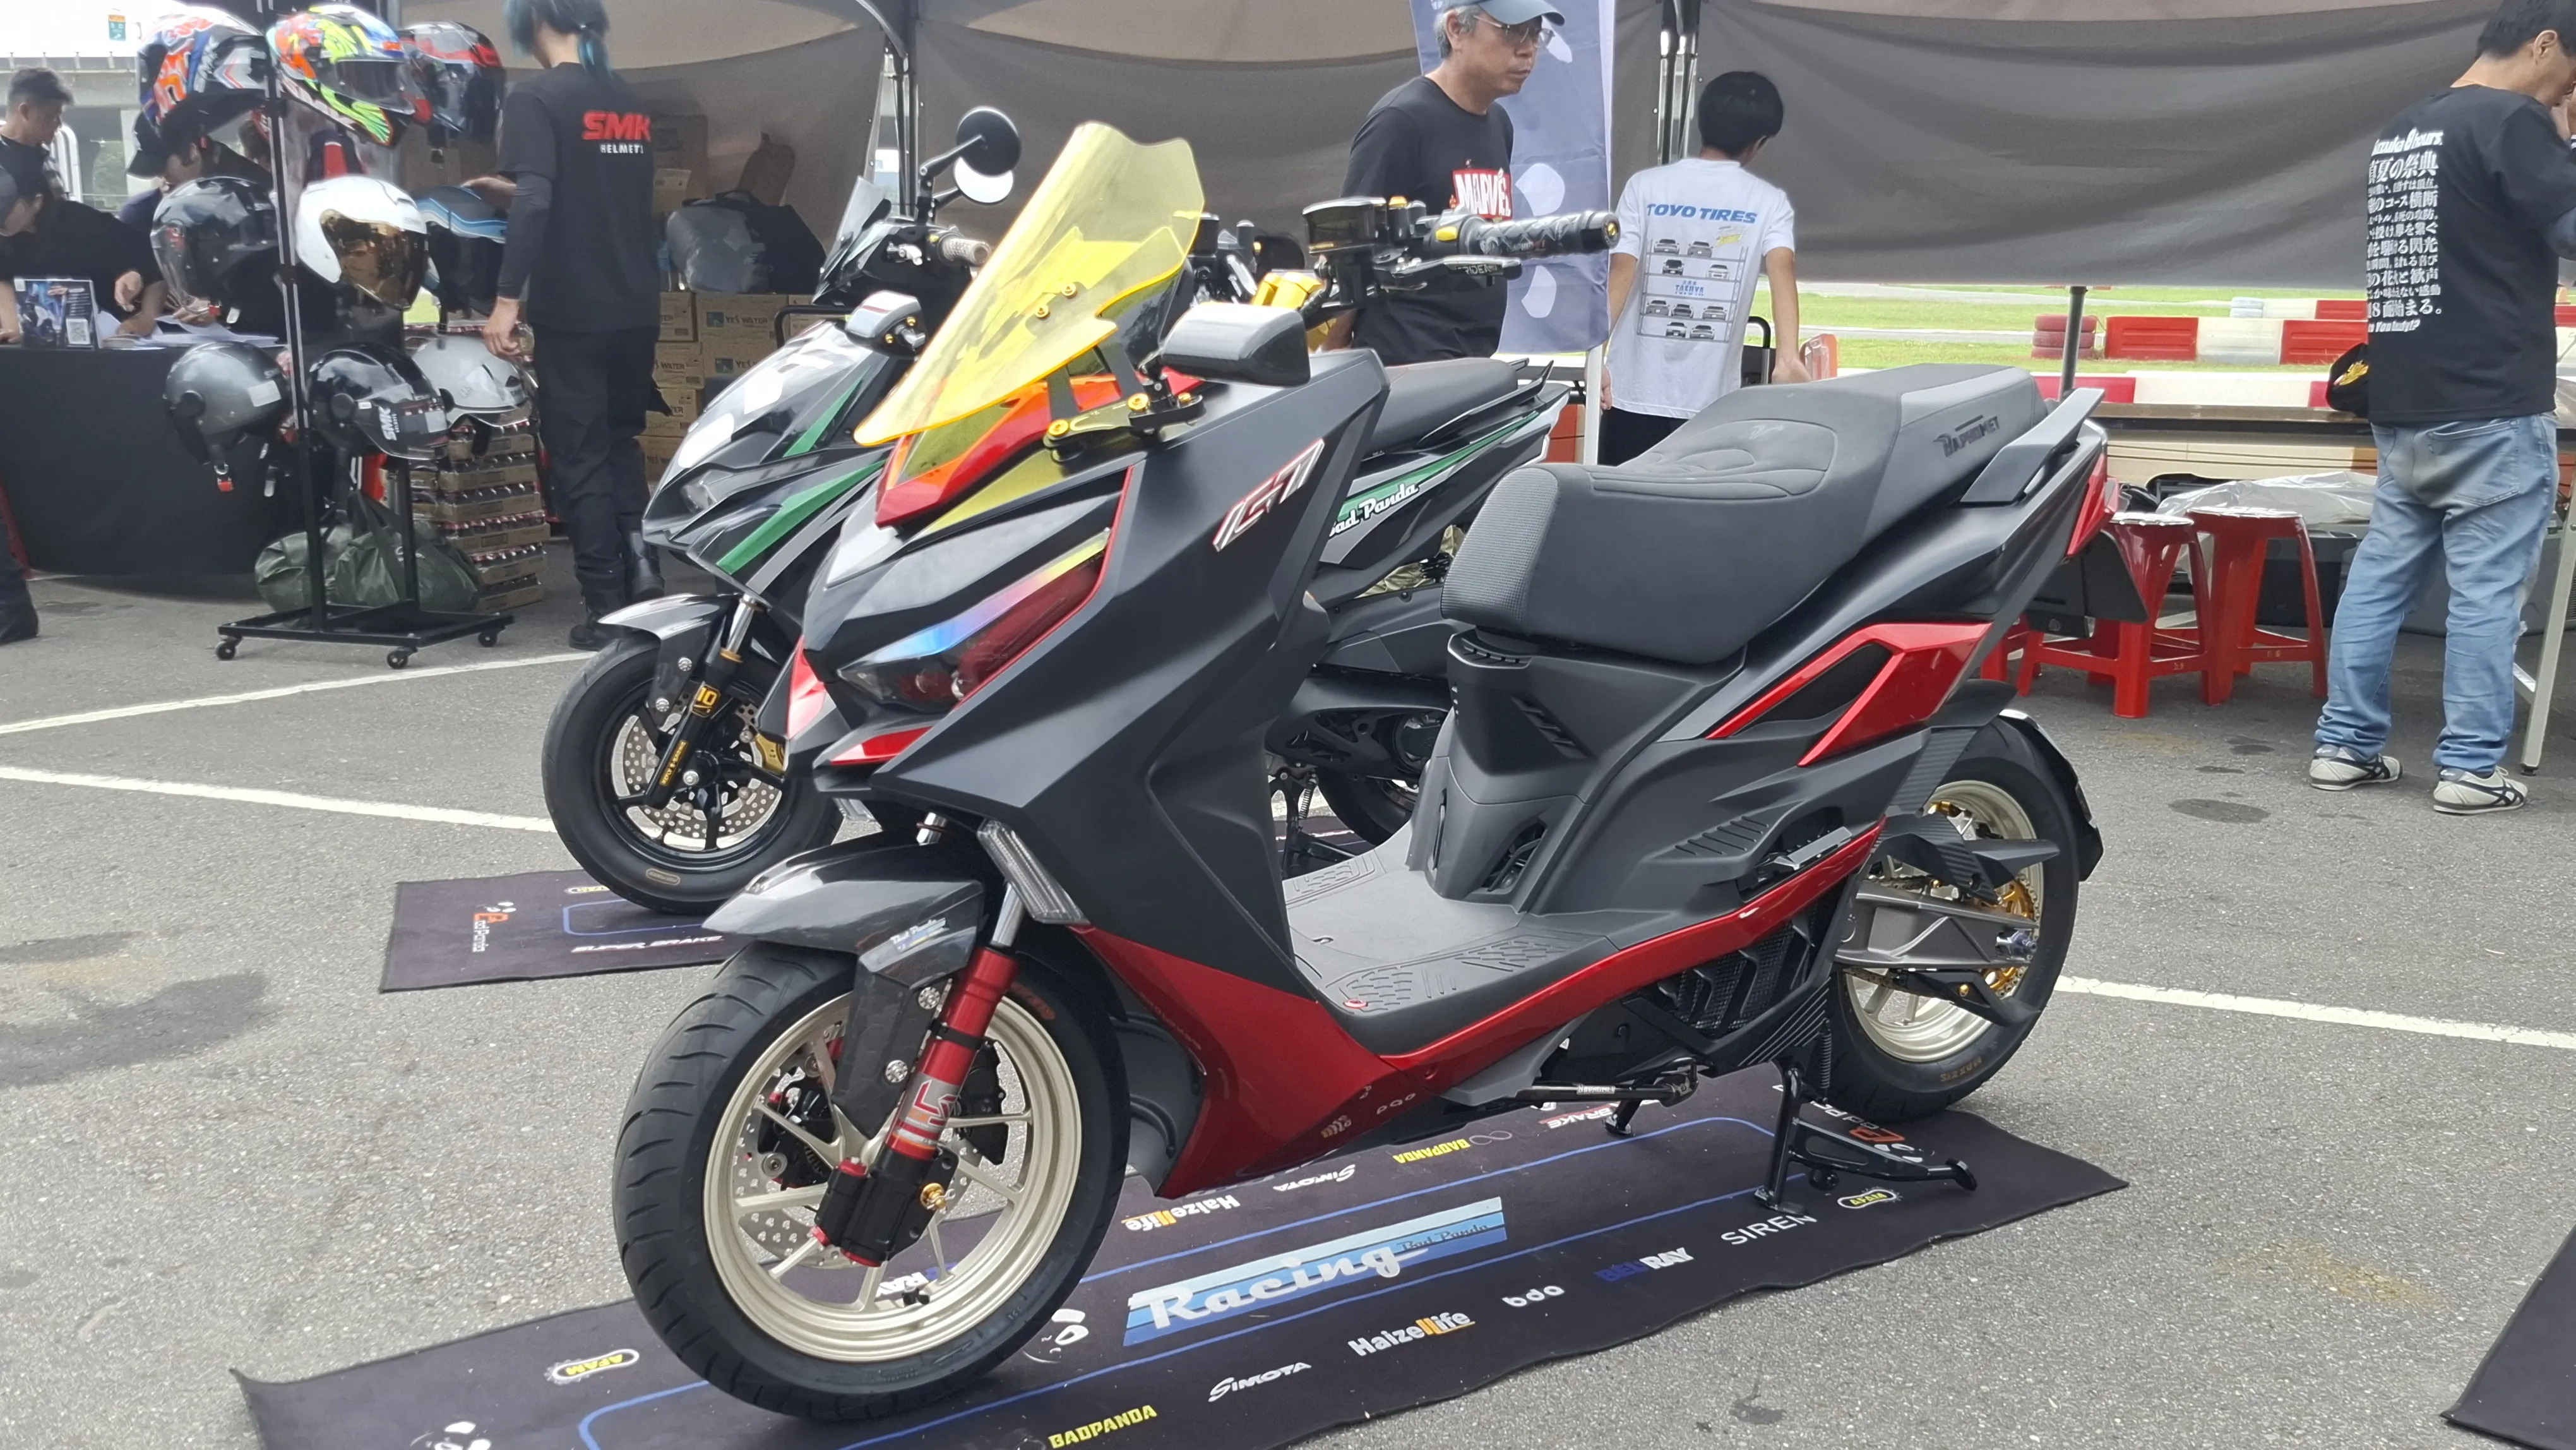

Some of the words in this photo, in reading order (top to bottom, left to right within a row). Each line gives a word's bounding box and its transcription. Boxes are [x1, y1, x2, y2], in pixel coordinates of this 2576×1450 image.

[583, 111, 651, 142] SMK
[1455, 173, 1512, 217] MARVEL
[1647, 203, 1696, 217] TOYO
[1700, 208, 1757, 224] TIRES
[1359, 483, 1419, 520] Panda
[1547, 1107, 1614, 1129] BRAKE
[1721, 1212, 1818, 1246] SIREN
[1143, 1244, 1429, 1331] Racing
[1503, 1285, 1566, 1308] bdo
[1048, 1405, 1158, 1449] BADPANDA
